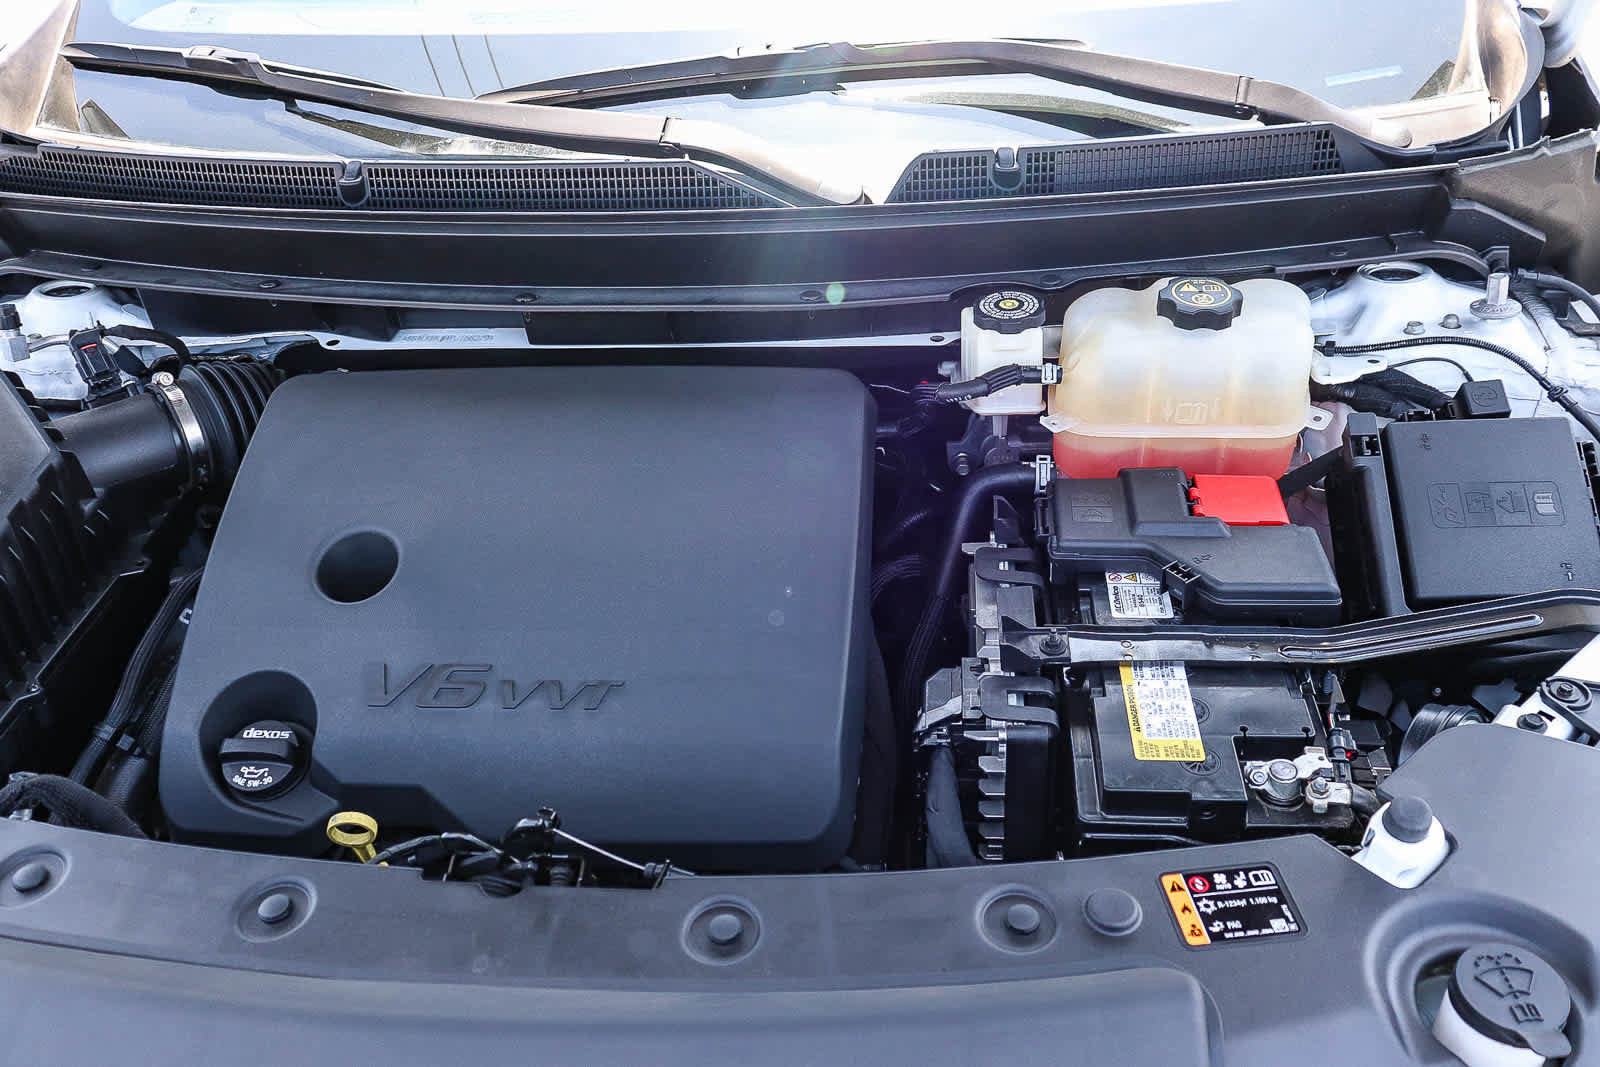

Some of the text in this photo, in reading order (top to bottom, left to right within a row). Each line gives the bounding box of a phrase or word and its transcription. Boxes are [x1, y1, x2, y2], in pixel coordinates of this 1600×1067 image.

[366, 663, 626, 711] V6 VVT
[1130, 704, 1140, 728] DANGER
[242, 728, 293, 739] dexos
[232, 775, 273, 787] SAE 5W-30
